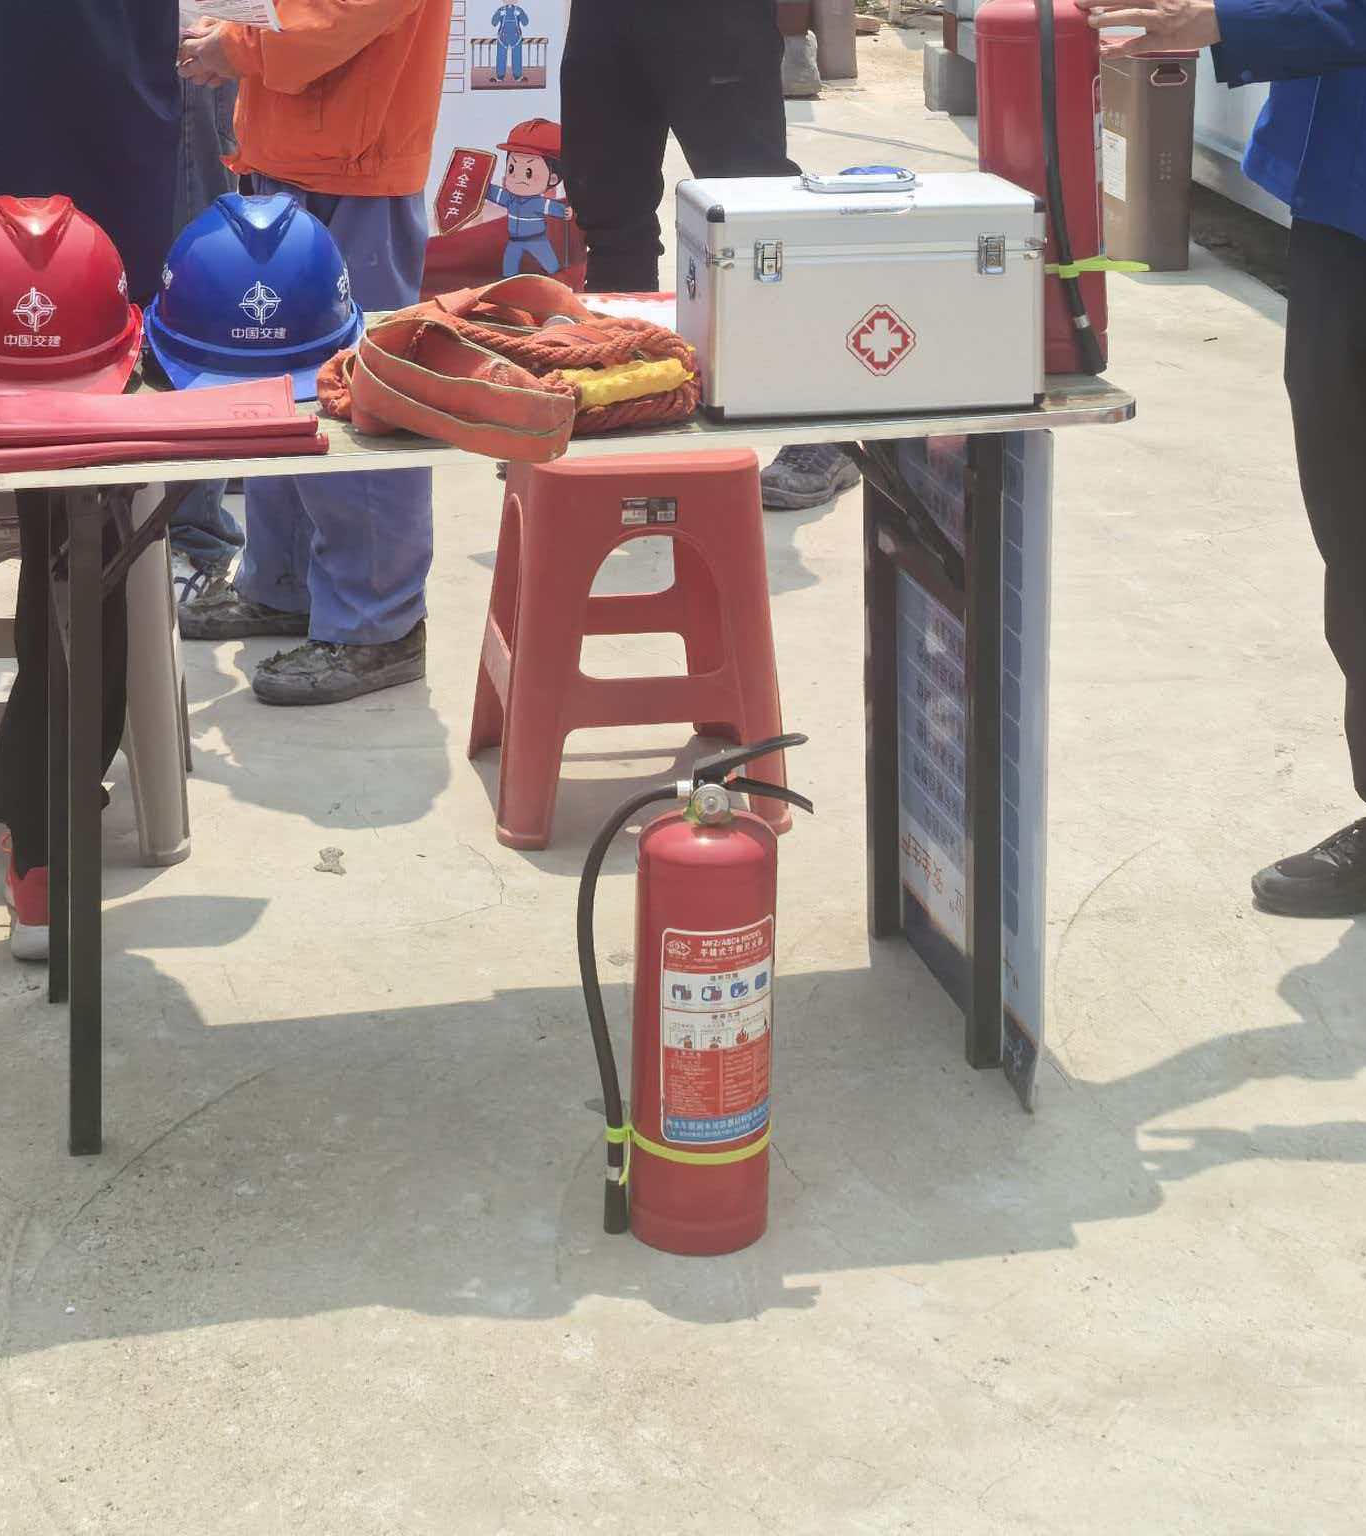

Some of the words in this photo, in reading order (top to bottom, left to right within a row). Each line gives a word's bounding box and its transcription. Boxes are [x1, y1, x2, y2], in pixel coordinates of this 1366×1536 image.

[231, 327, 287, 340] 中国交建
[4, 334, 62, 348] 中国交建
